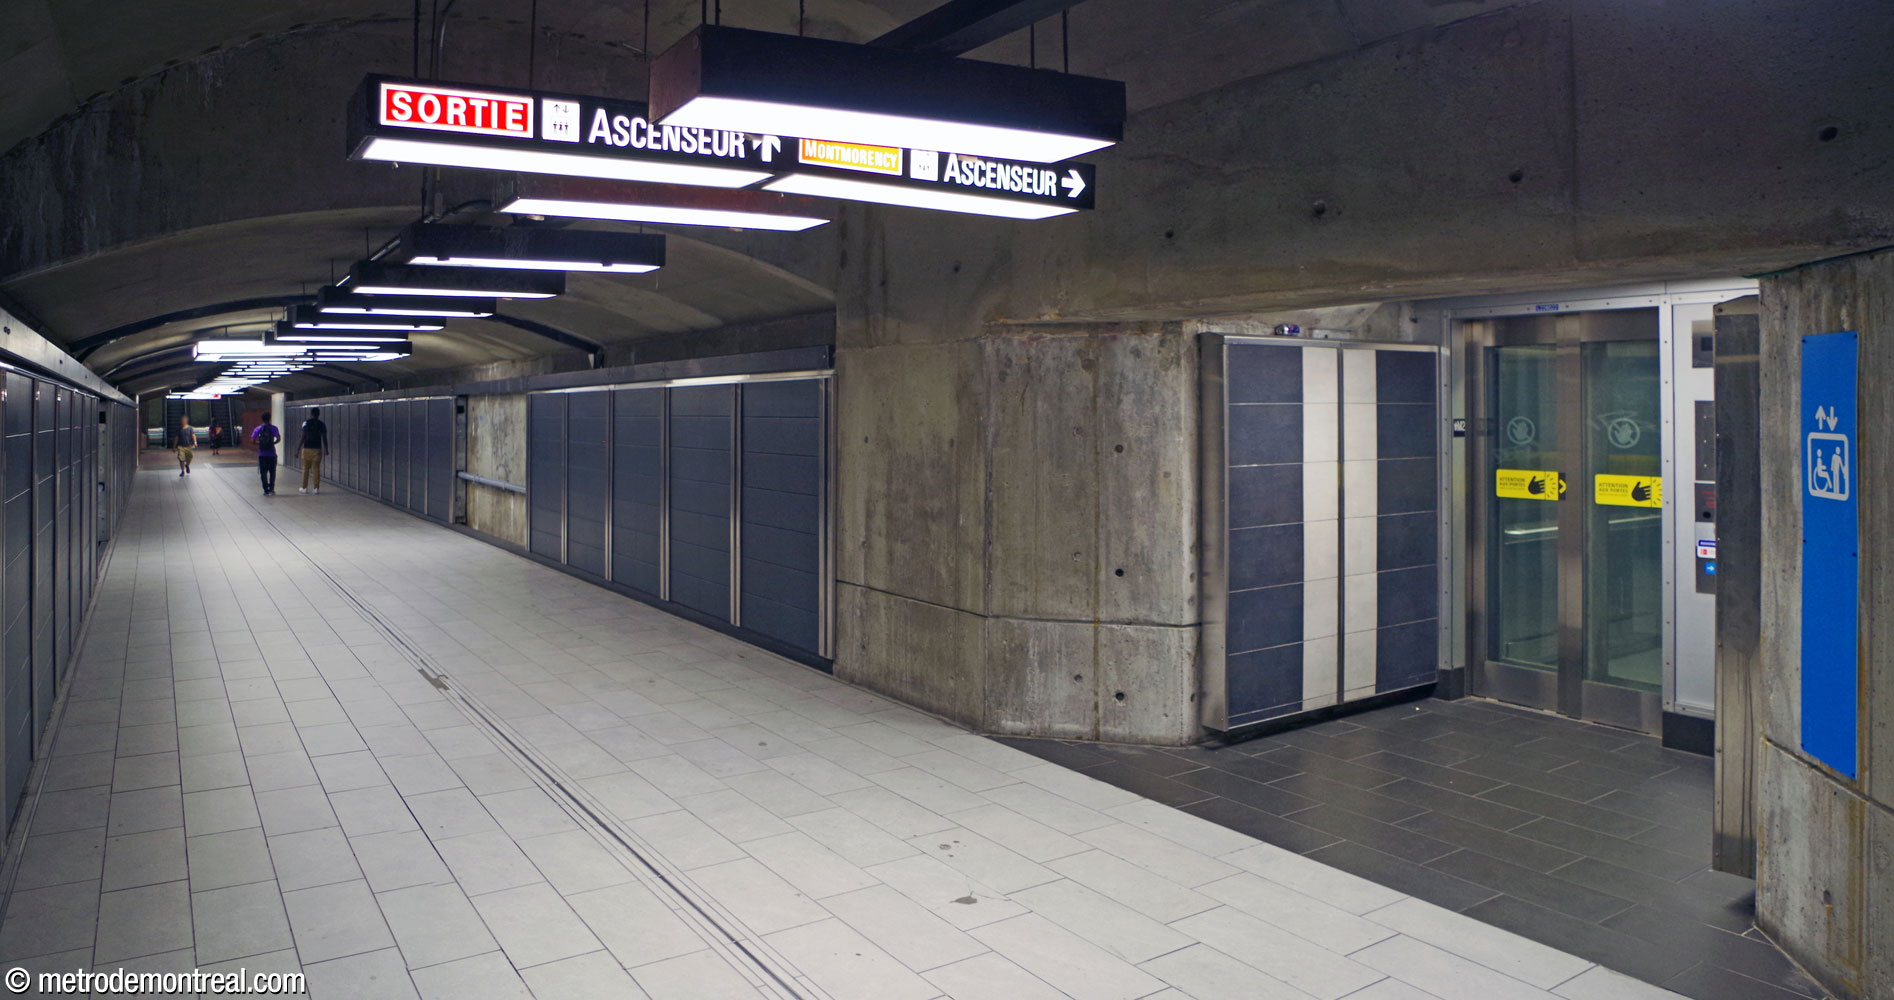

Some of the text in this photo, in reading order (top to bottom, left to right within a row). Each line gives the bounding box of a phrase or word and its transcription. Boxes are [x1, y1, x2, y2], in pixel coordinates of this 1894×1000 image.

[391, 91, 524, 131] SORTIE
[588, 107, 746, 159] ASCENSEUR
[804, 139, 898, 169] MONTMORENCY
[943, 152, 1057, 197] ASCENSEUR
